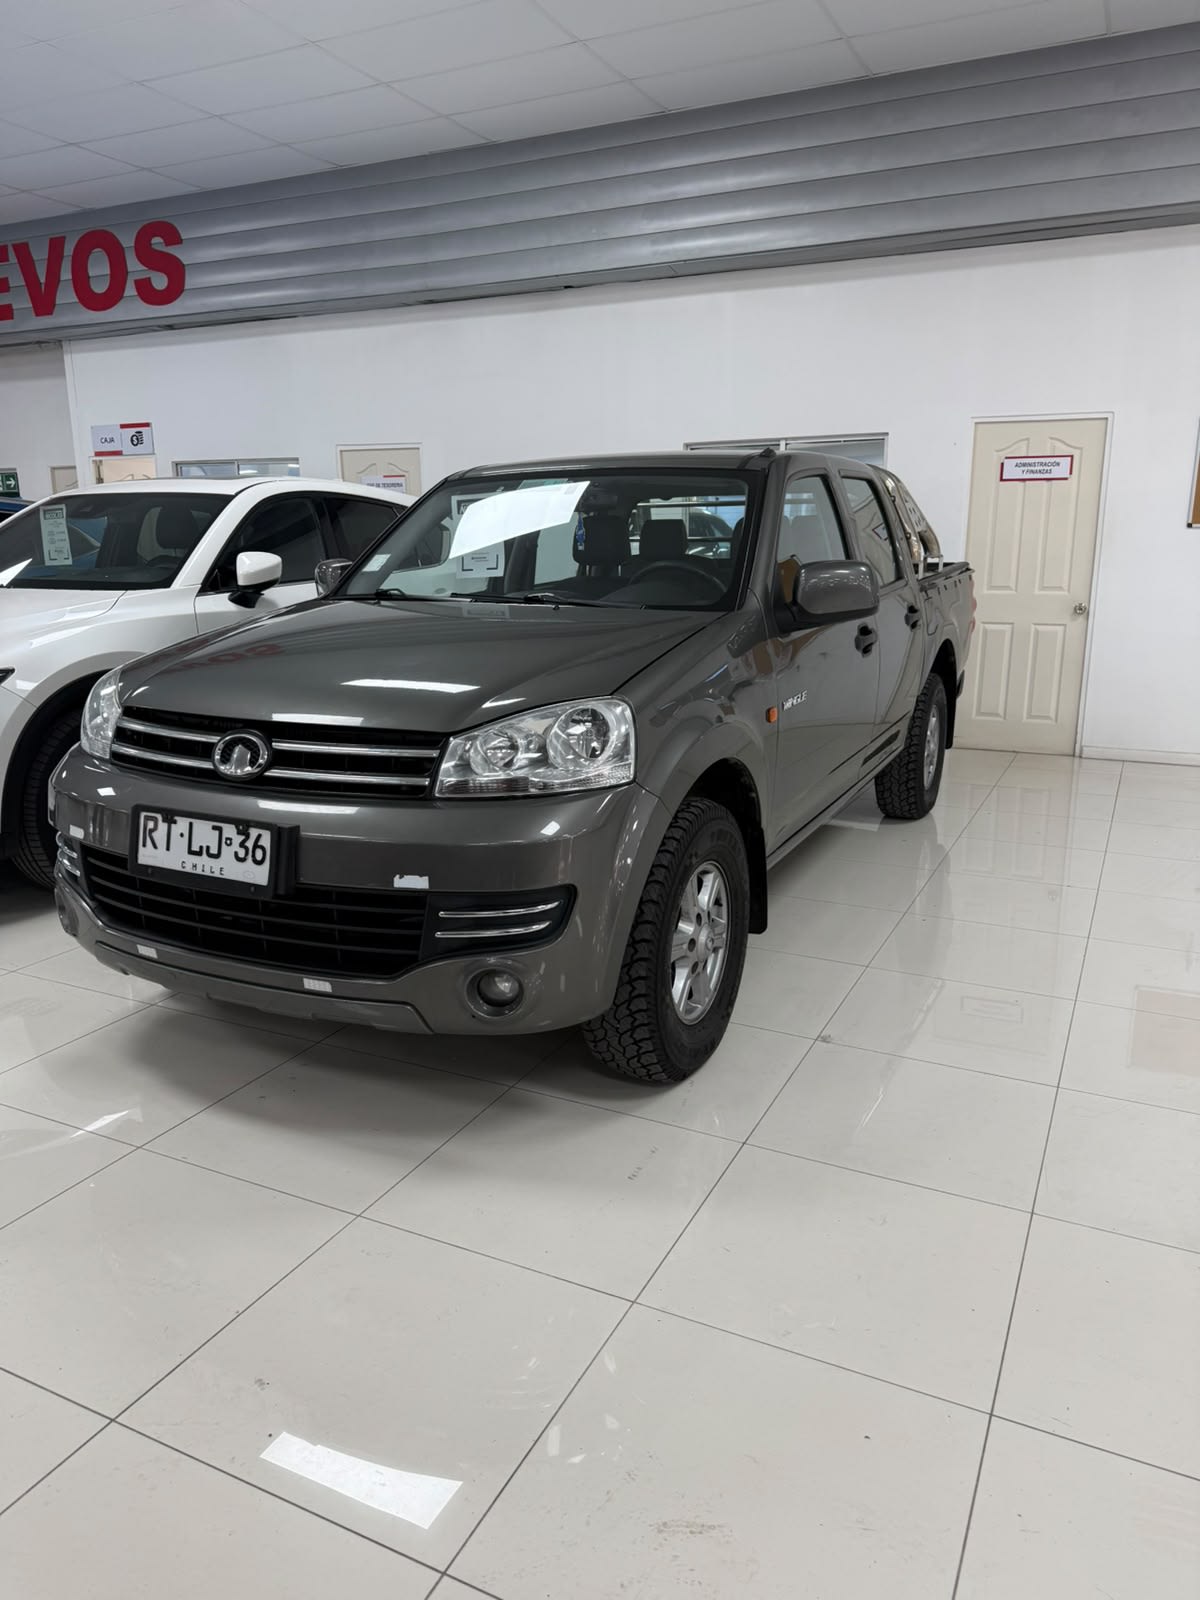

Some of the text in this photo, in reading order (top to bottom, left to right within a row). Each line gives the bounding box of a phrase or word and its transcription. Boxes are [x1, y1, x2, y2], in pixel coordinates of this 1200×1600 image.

[100, 436, 115, 444] CAJA
[1014, 460, 1060, 468] ADMINISTRACIÓN
[181, 861, 225, 876] CHILE
